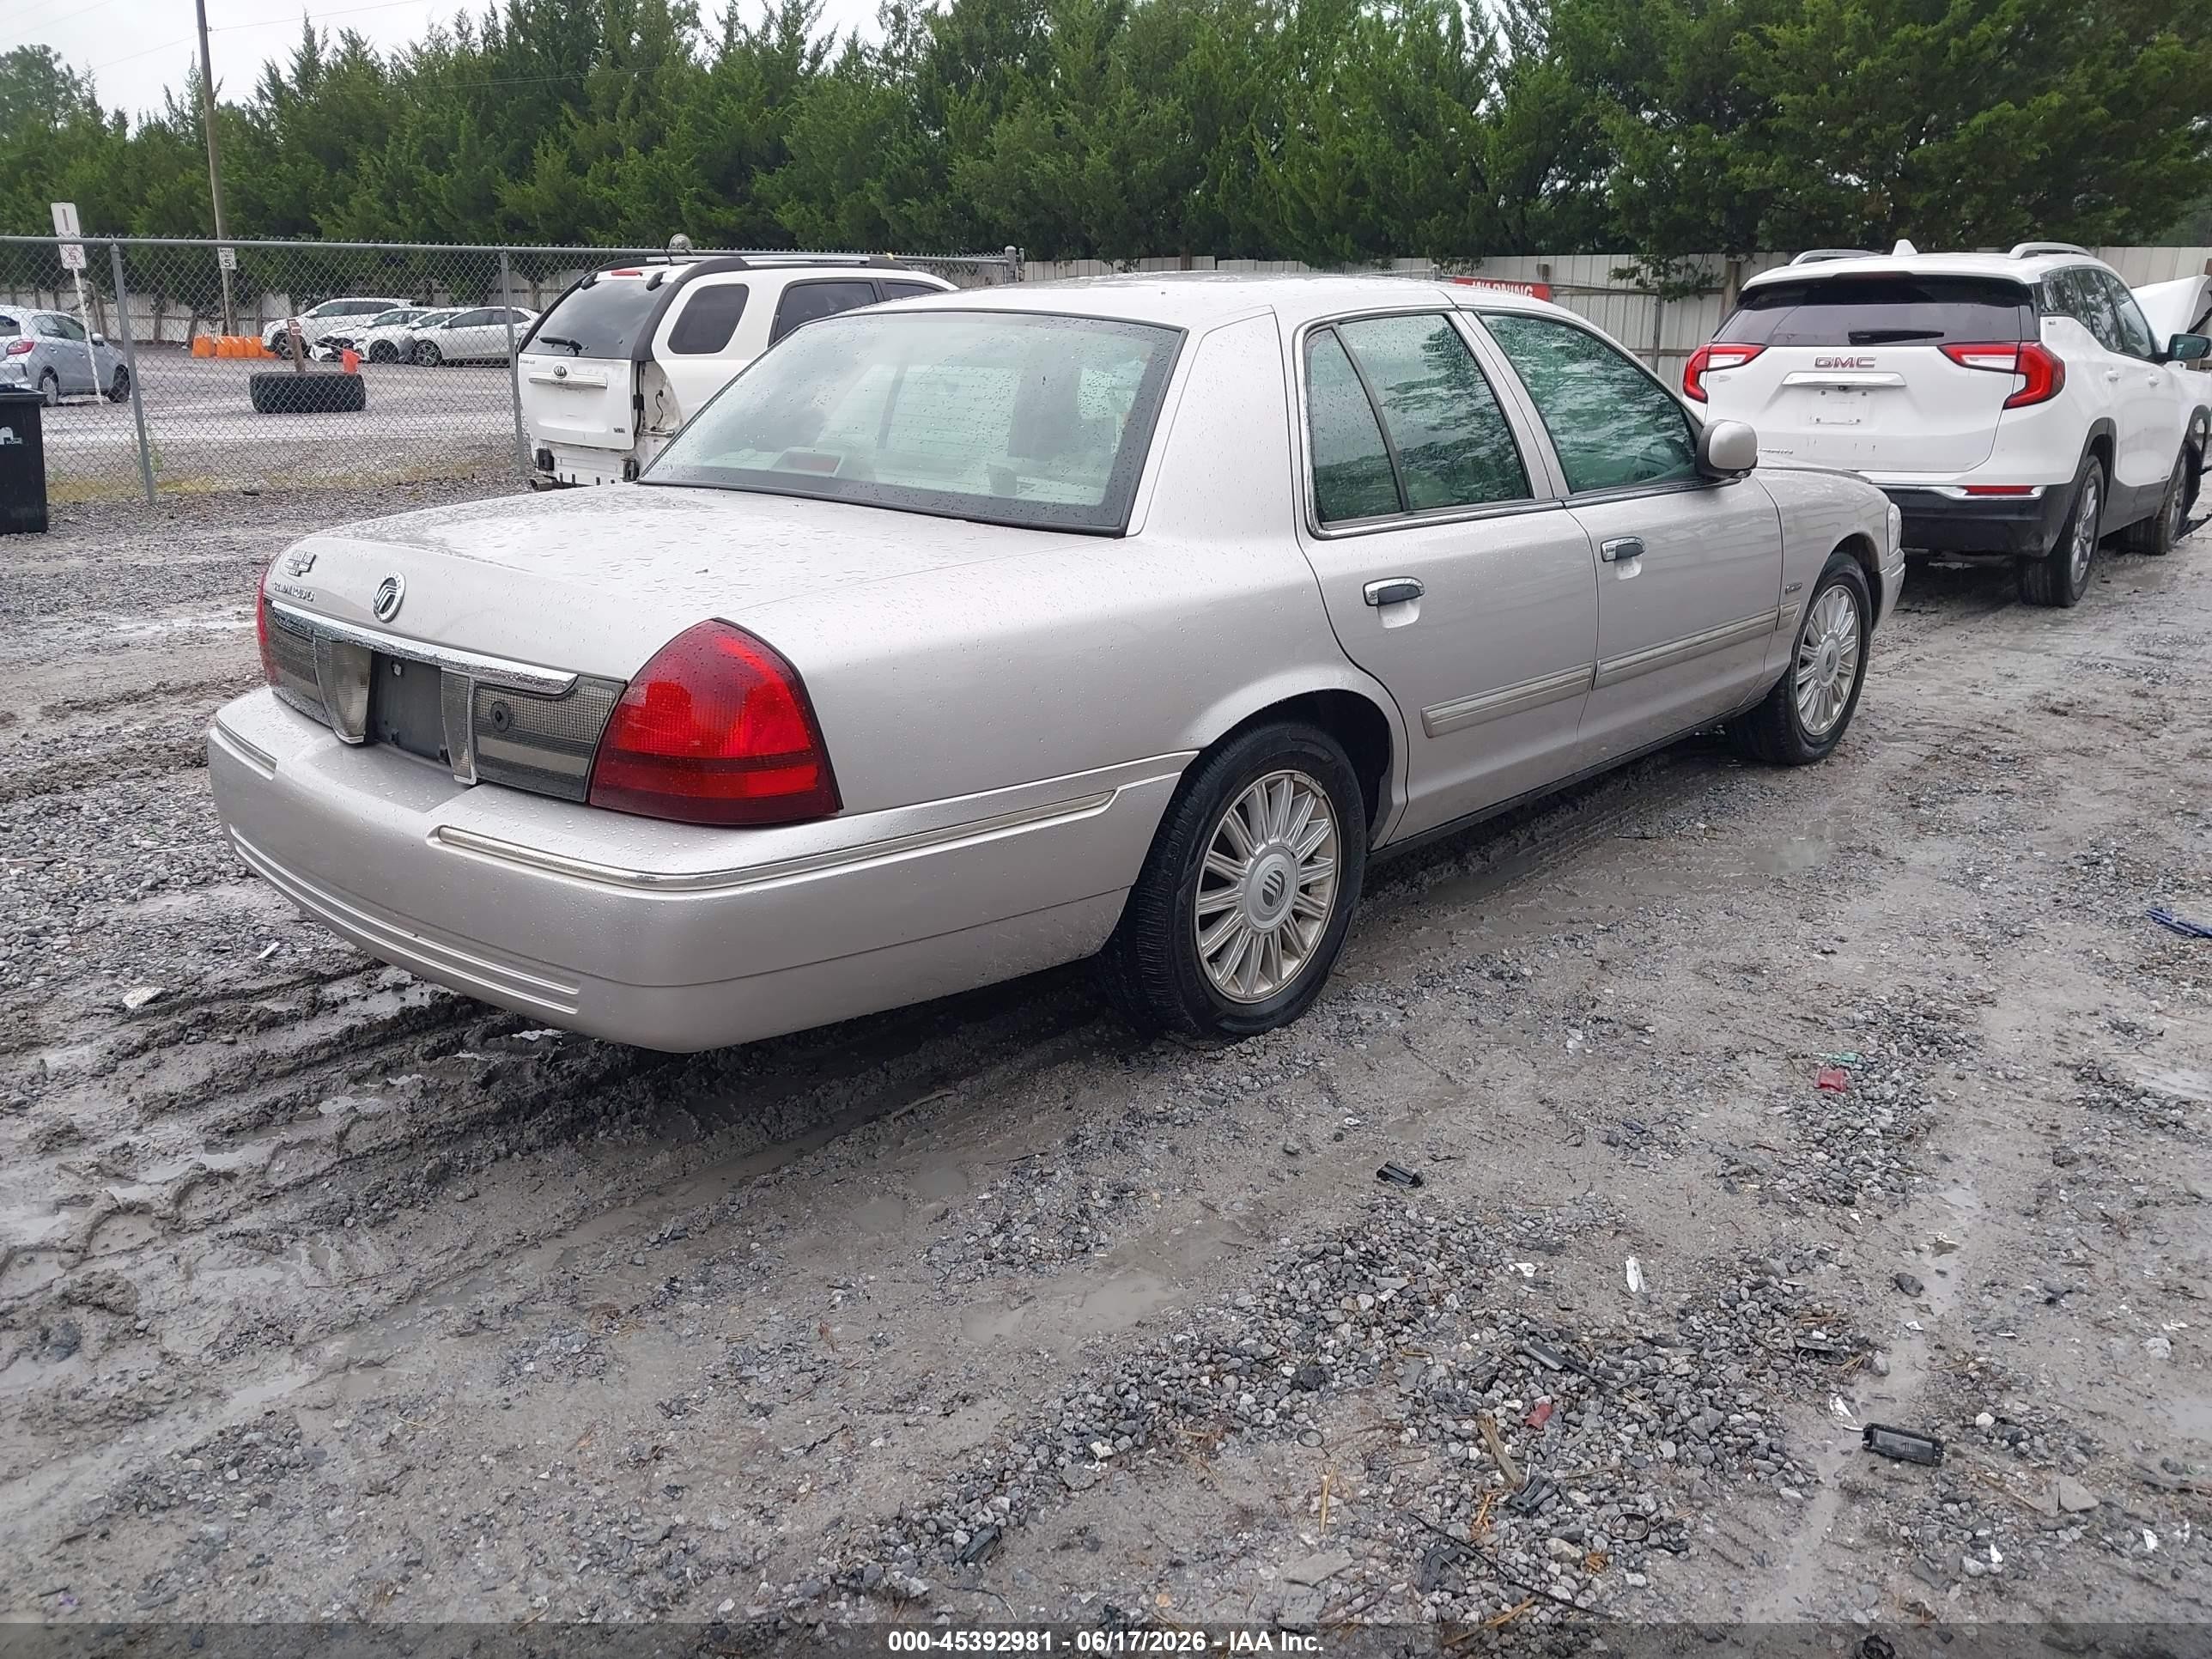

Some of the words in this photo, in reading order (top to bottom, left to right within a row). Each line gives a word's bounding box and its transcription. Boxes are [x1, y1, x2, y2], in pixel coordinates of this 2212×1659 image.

[224, 258, 231, 267] 5
[1814, 356, 1876, 368] GMC
[554, 366, 567, 377] KIA
